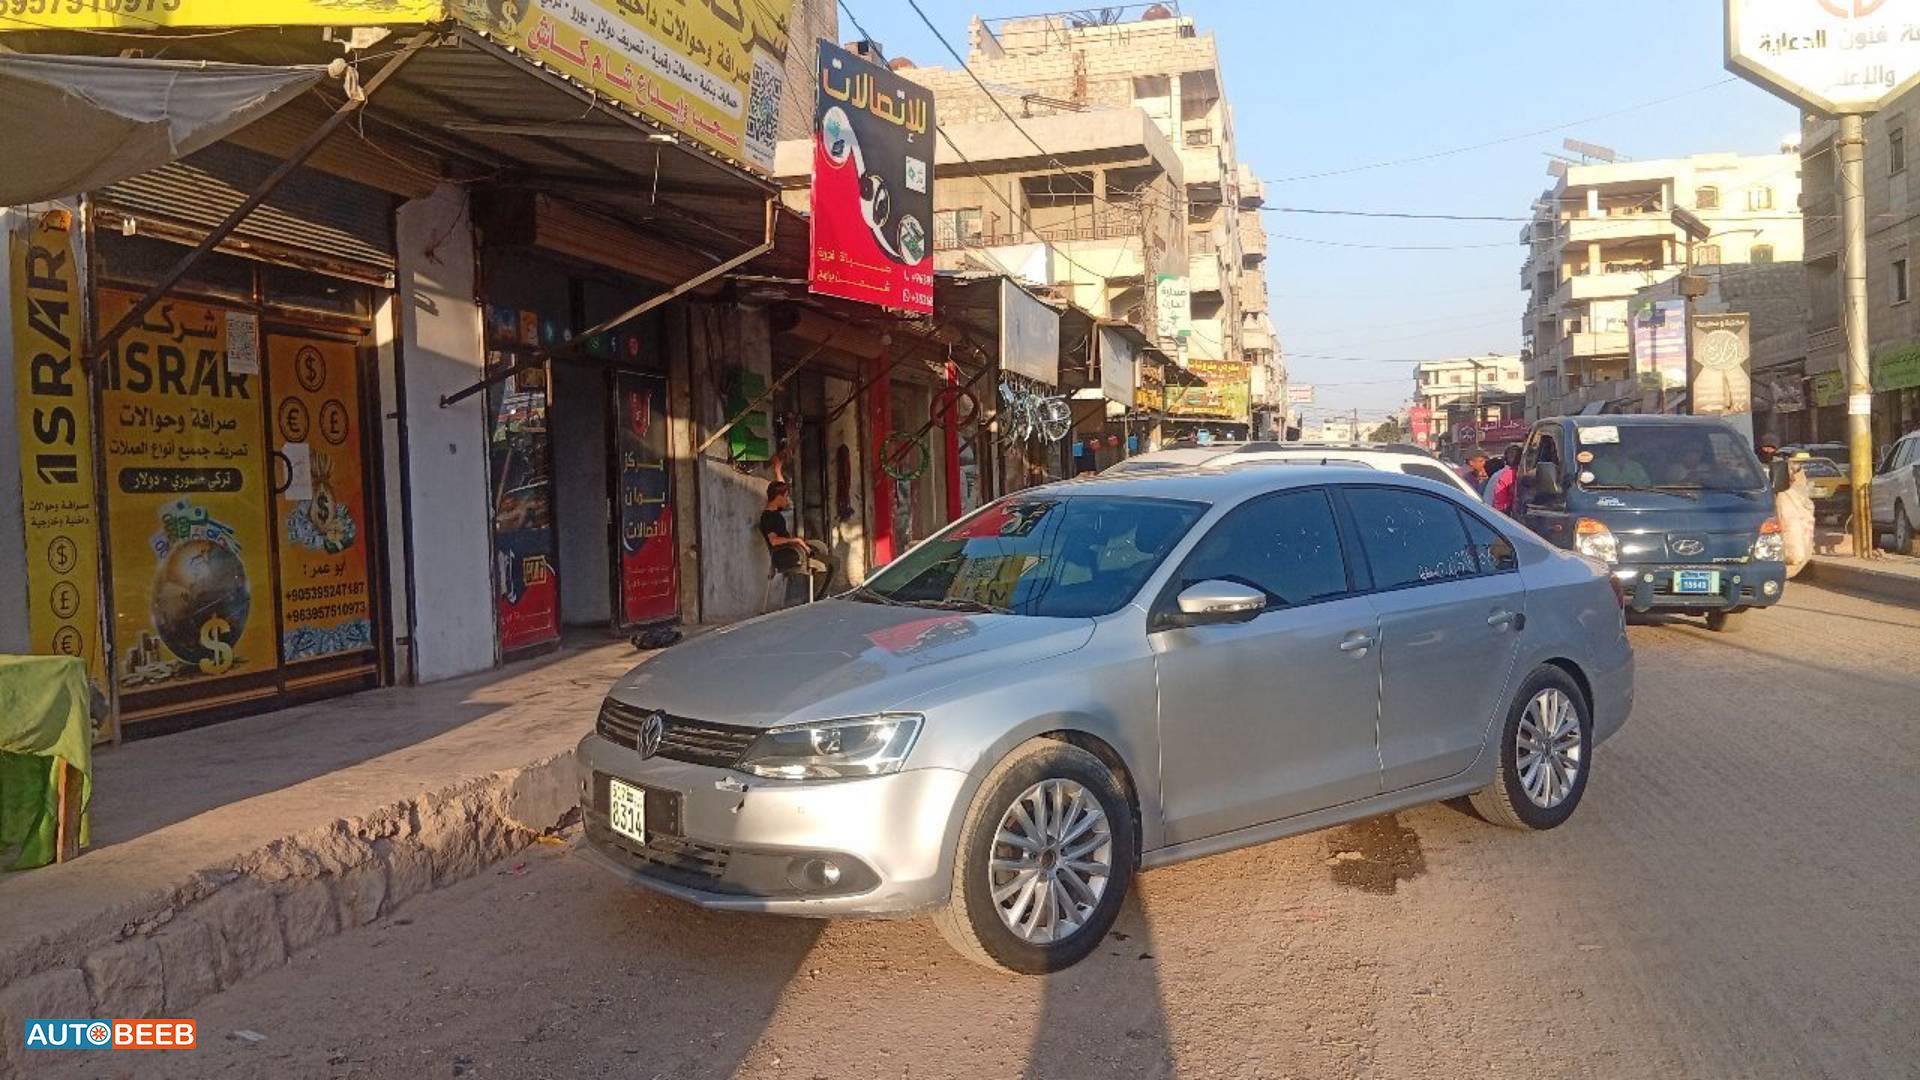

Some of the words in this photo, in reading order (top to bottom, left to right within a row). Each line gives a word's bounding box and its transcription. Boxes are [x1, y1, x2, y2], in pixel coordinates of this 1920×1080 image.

[119, 405, 186, 434] وحوالات
[192, 407, 238, 434] صرافة
[109, 440, 149, 456] العملات
[178, 445, 211, 461] جميع
[213, 442, 249, 460] تصريف
[133, 471, 160, 489] دولار
[612, 800, 643, 837] 8314
